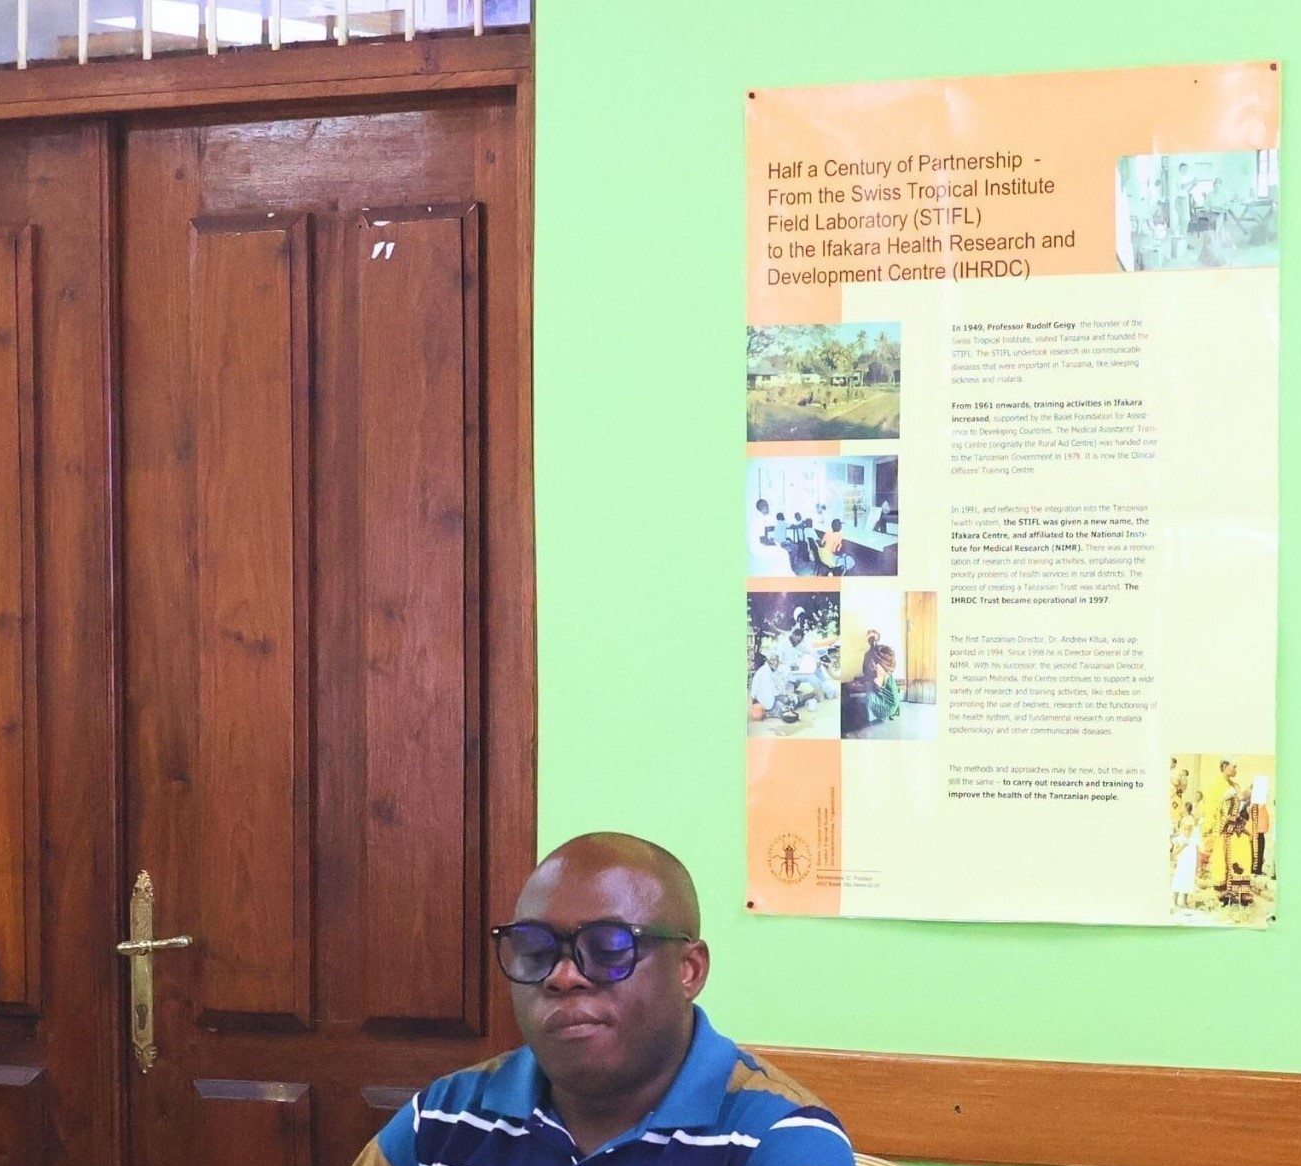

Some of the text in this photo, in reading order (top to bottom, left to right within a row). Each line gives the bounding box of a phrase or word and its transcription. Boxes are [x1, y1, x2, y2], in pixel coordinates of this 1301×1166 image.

[769, 161, 803, 179] Half
[808, 165, 817, 177] a
[824, 160, 891, 178] Century
[897, 155, 913, 173] of
[919, 151, 1022, 172] Partnership
[769, 178, 1054, 205] From the Swiss Tropical Institute
[768, 207, 981, 232] Field Laboratory (STIFL)
[768, 230, 1074, 258] to the Ifakara Health Research and
[769, 259, 1030, 287] Development Centre (IHRDC)
[964, 323, 984, 333] 1949,
[987, 322, 1024, 331] Professor
[1026, 321, 1051, 330] Rudolf
[952, 398, 1142, 410] From 1961 onwards, training activities in Ifakara
[982, 465, 1011, 476] Training
[1004, 517, 1016, 526] the
[1019, 517, 1040, 526] STIFL
[1061, 517, 1081, 527] given
[1110, 518, 1133, 526] name,
[1136, 517, 1149, 525] the
[952, 530, 1147, 540] Ifakara Centre, and affiliated to the National Insti-
[951, 543, 1082, 554] tute for Medical Research (NIMR).
[1124, 582, 1139, 591] The
[951, 596, 977, 604] IHRDC
[980, 595, 999, 604] Trust
[1002, 595, 1031, 604] became
[1033, 595, 1077, 606] operational
[1079, 595, 1086, 604] in
[1003, 777, 1143, 789] to carry out research and training to
[949, 790, 1118, 802] improve the health of the Tanzanian people.
